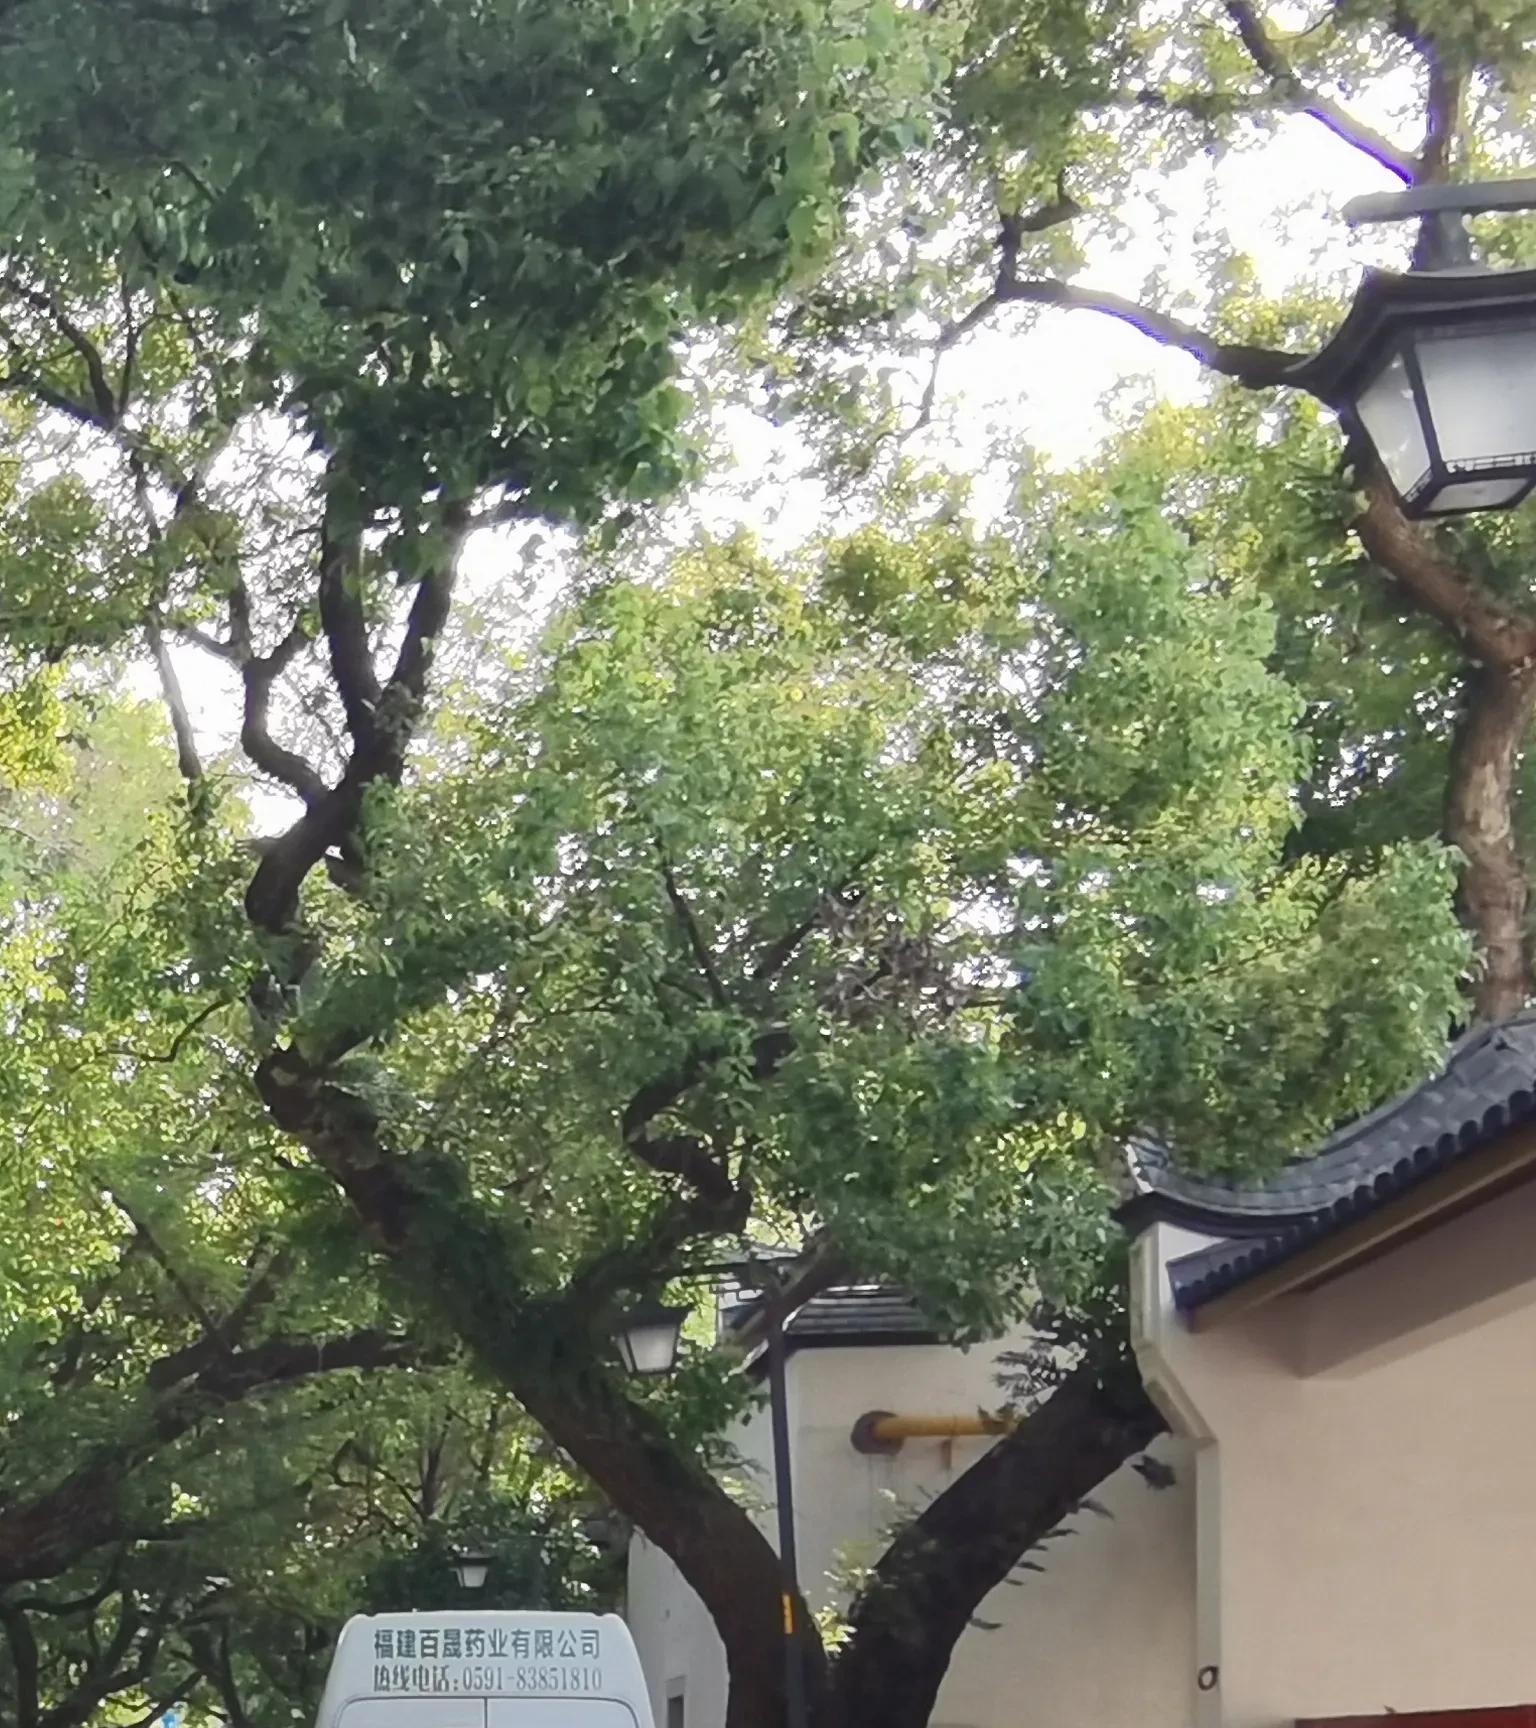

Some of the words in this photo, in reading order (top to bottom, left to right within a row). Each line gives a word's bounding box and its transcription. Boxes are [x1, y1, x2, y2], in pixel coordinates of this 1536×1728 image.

[373, 1628, 600, 1659] 福建百晟药业有限公司
